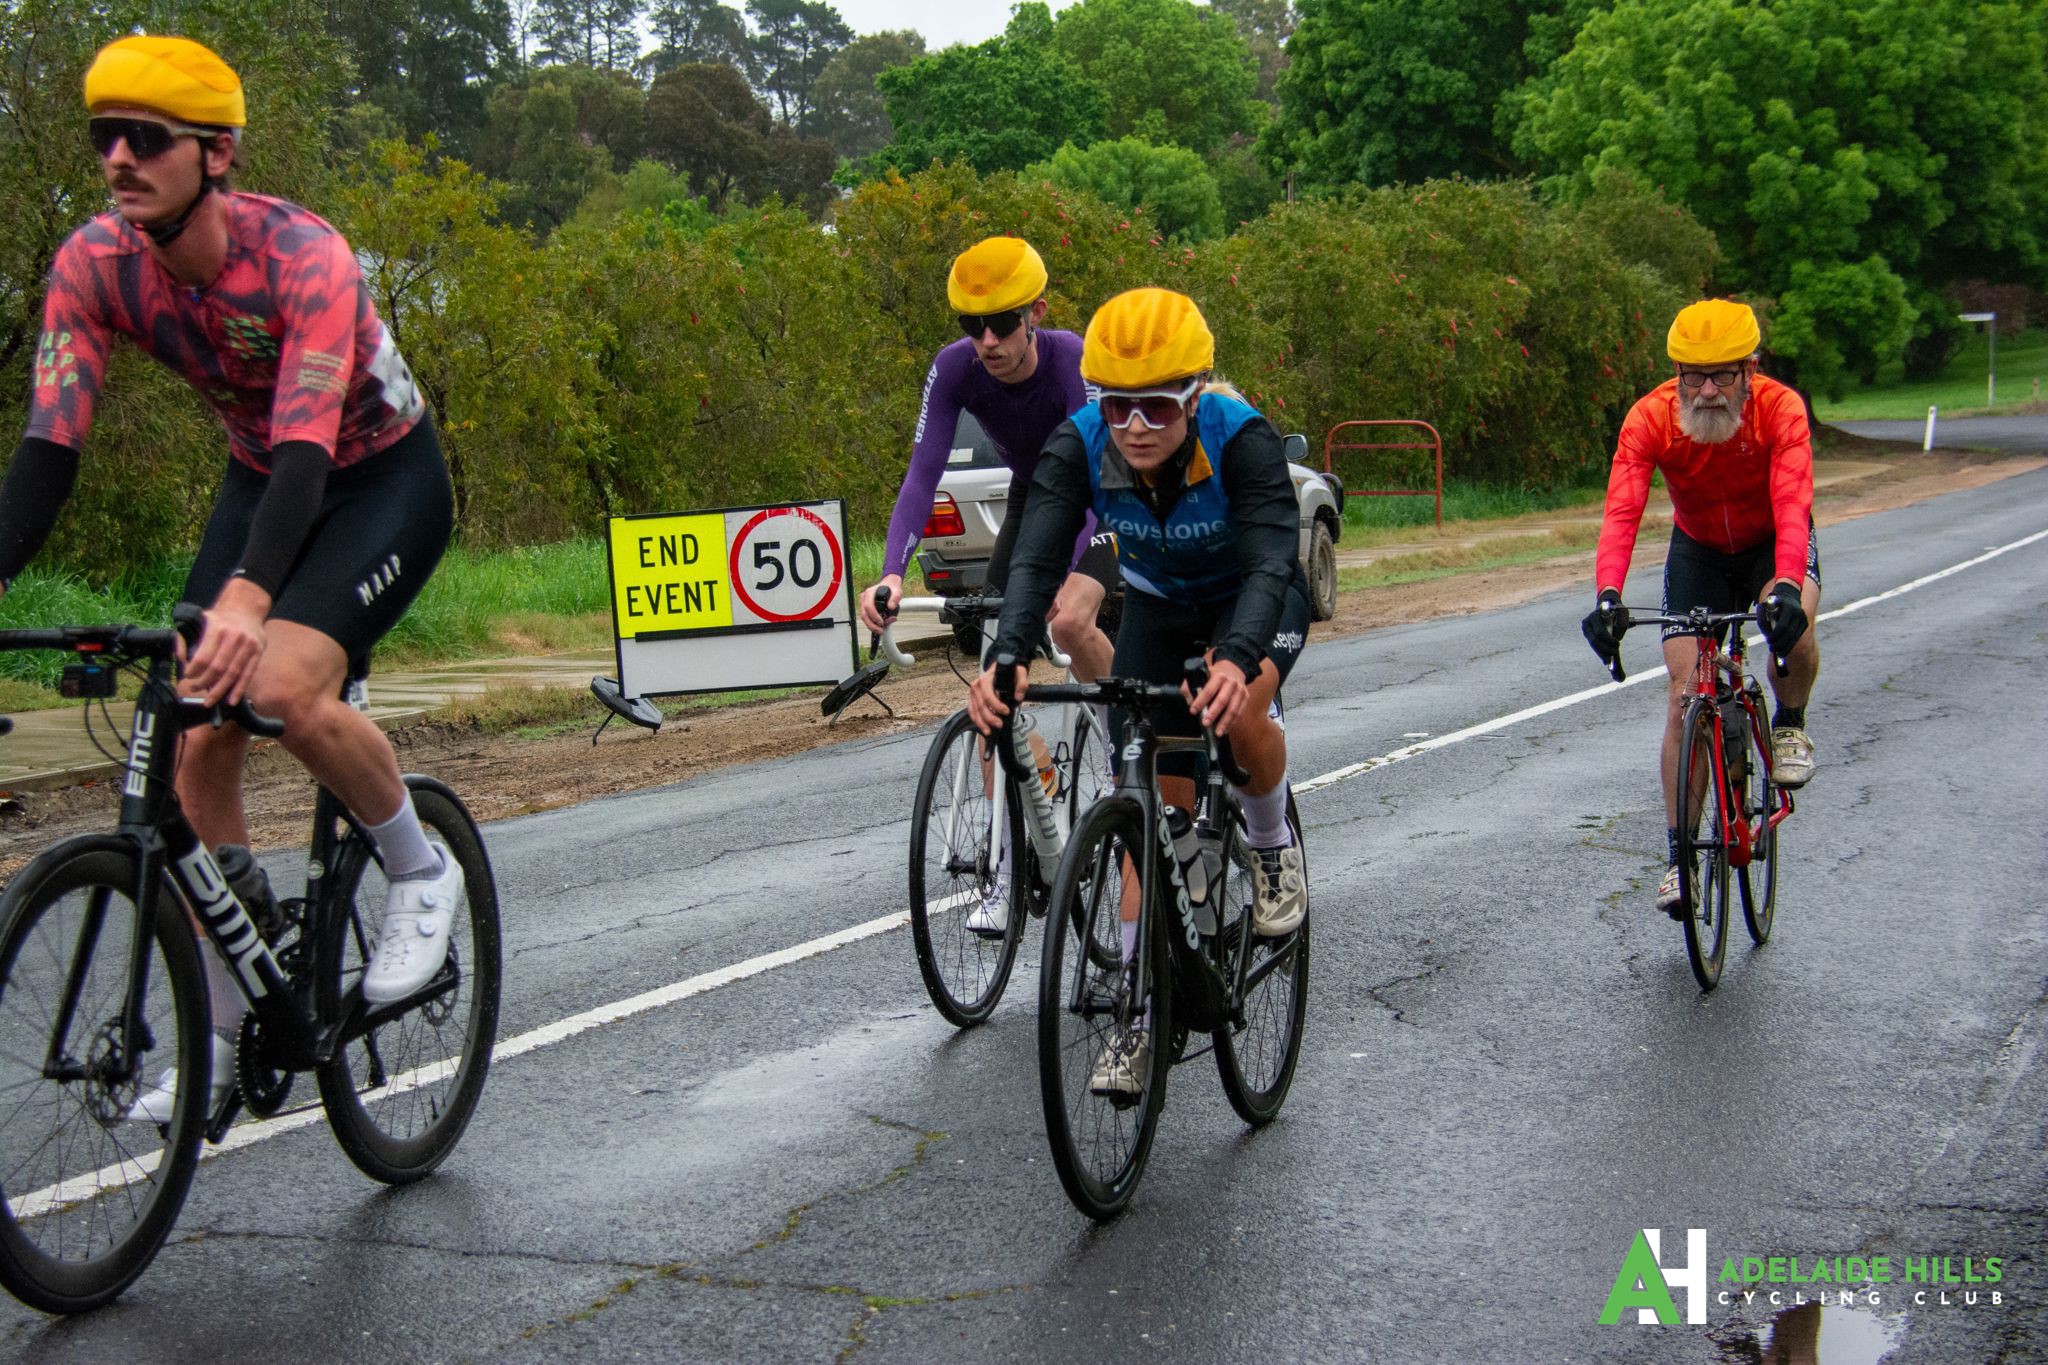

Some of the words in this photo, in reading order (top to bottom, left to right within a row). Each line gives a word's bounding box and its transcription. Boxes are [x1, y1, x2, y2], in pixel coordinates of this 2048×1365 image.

[914, 364, 938, 443] ATTAQUER
[638, 533, 700, 568] END
[1103, 512, 1226, 541] keystone
[358, 554, 401, 606] MAAP
[753, 539, 822, 590] 50
[626, 580, 718, 617] EVENT
[125, 711, 156, 798] BMC
[178, 841, 285, 998] BMC
